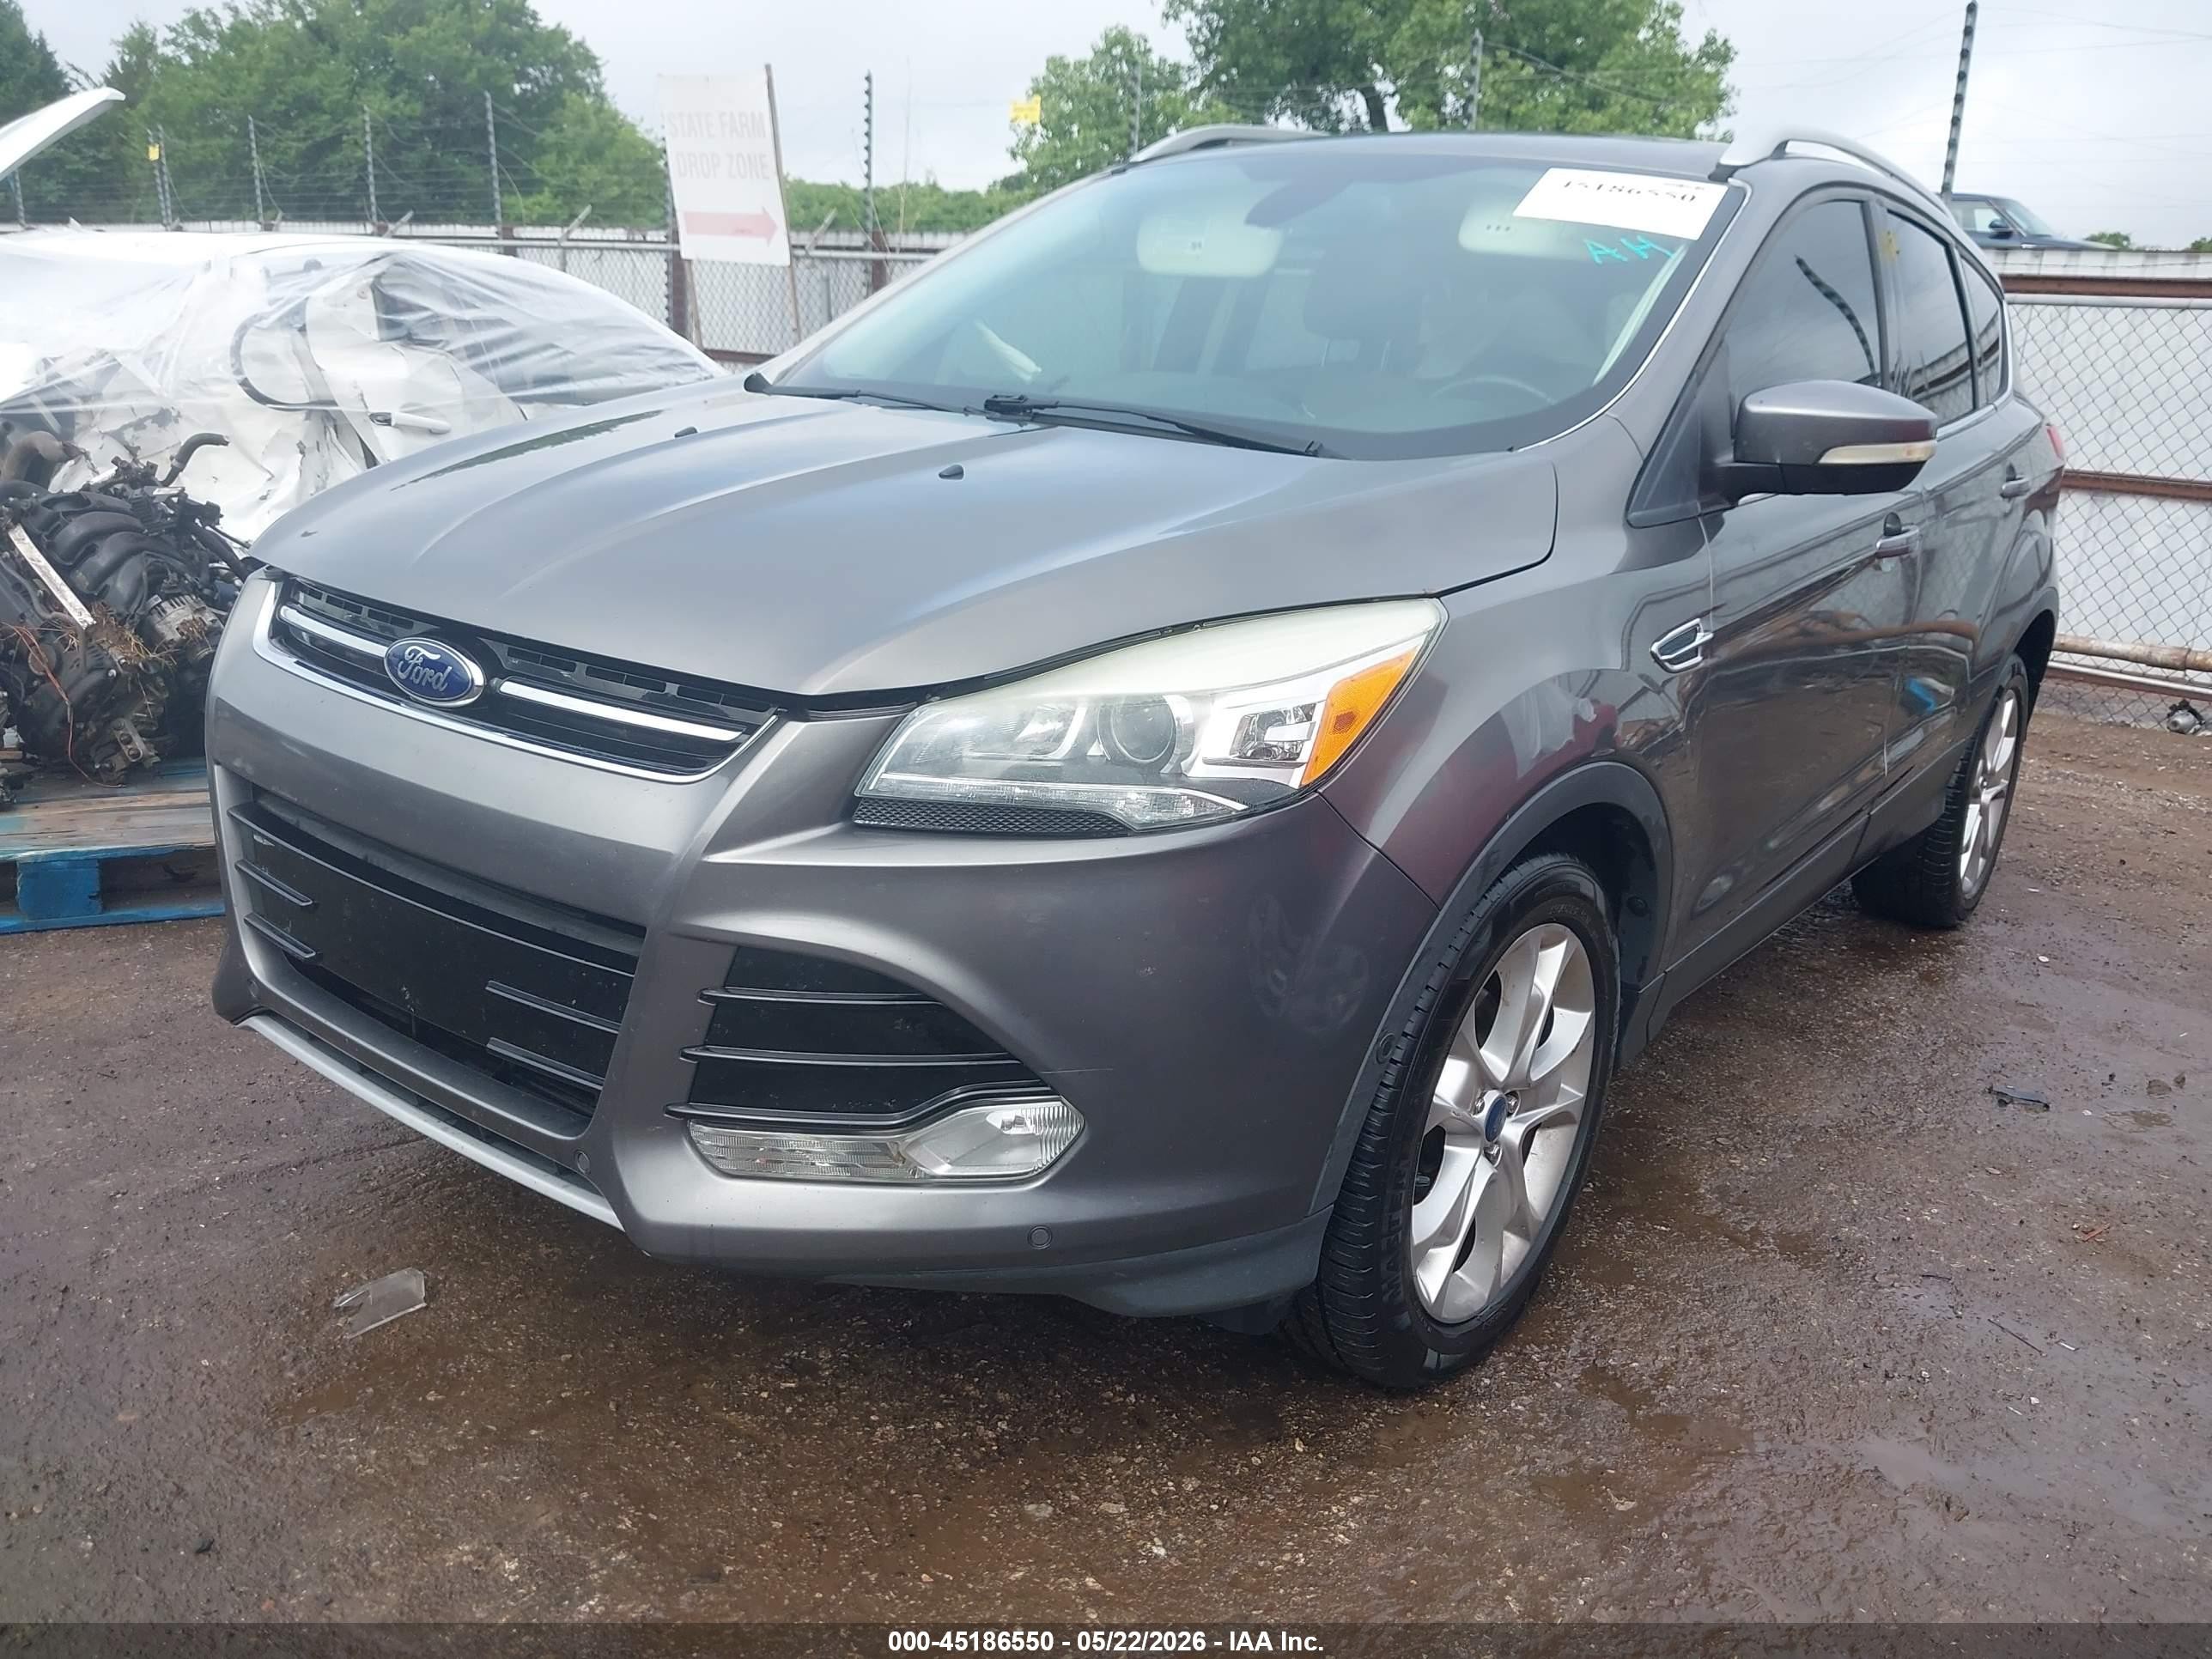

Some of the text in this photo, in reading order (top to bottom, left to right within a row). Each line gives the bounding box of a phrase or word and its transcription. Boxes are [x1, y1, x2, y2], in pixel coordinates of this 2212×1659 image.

[666, 111, 767, 138] STATE FARM
[676, 152, 770, 179] DROP ZONE
[398, 645, 453, 691] Ford
